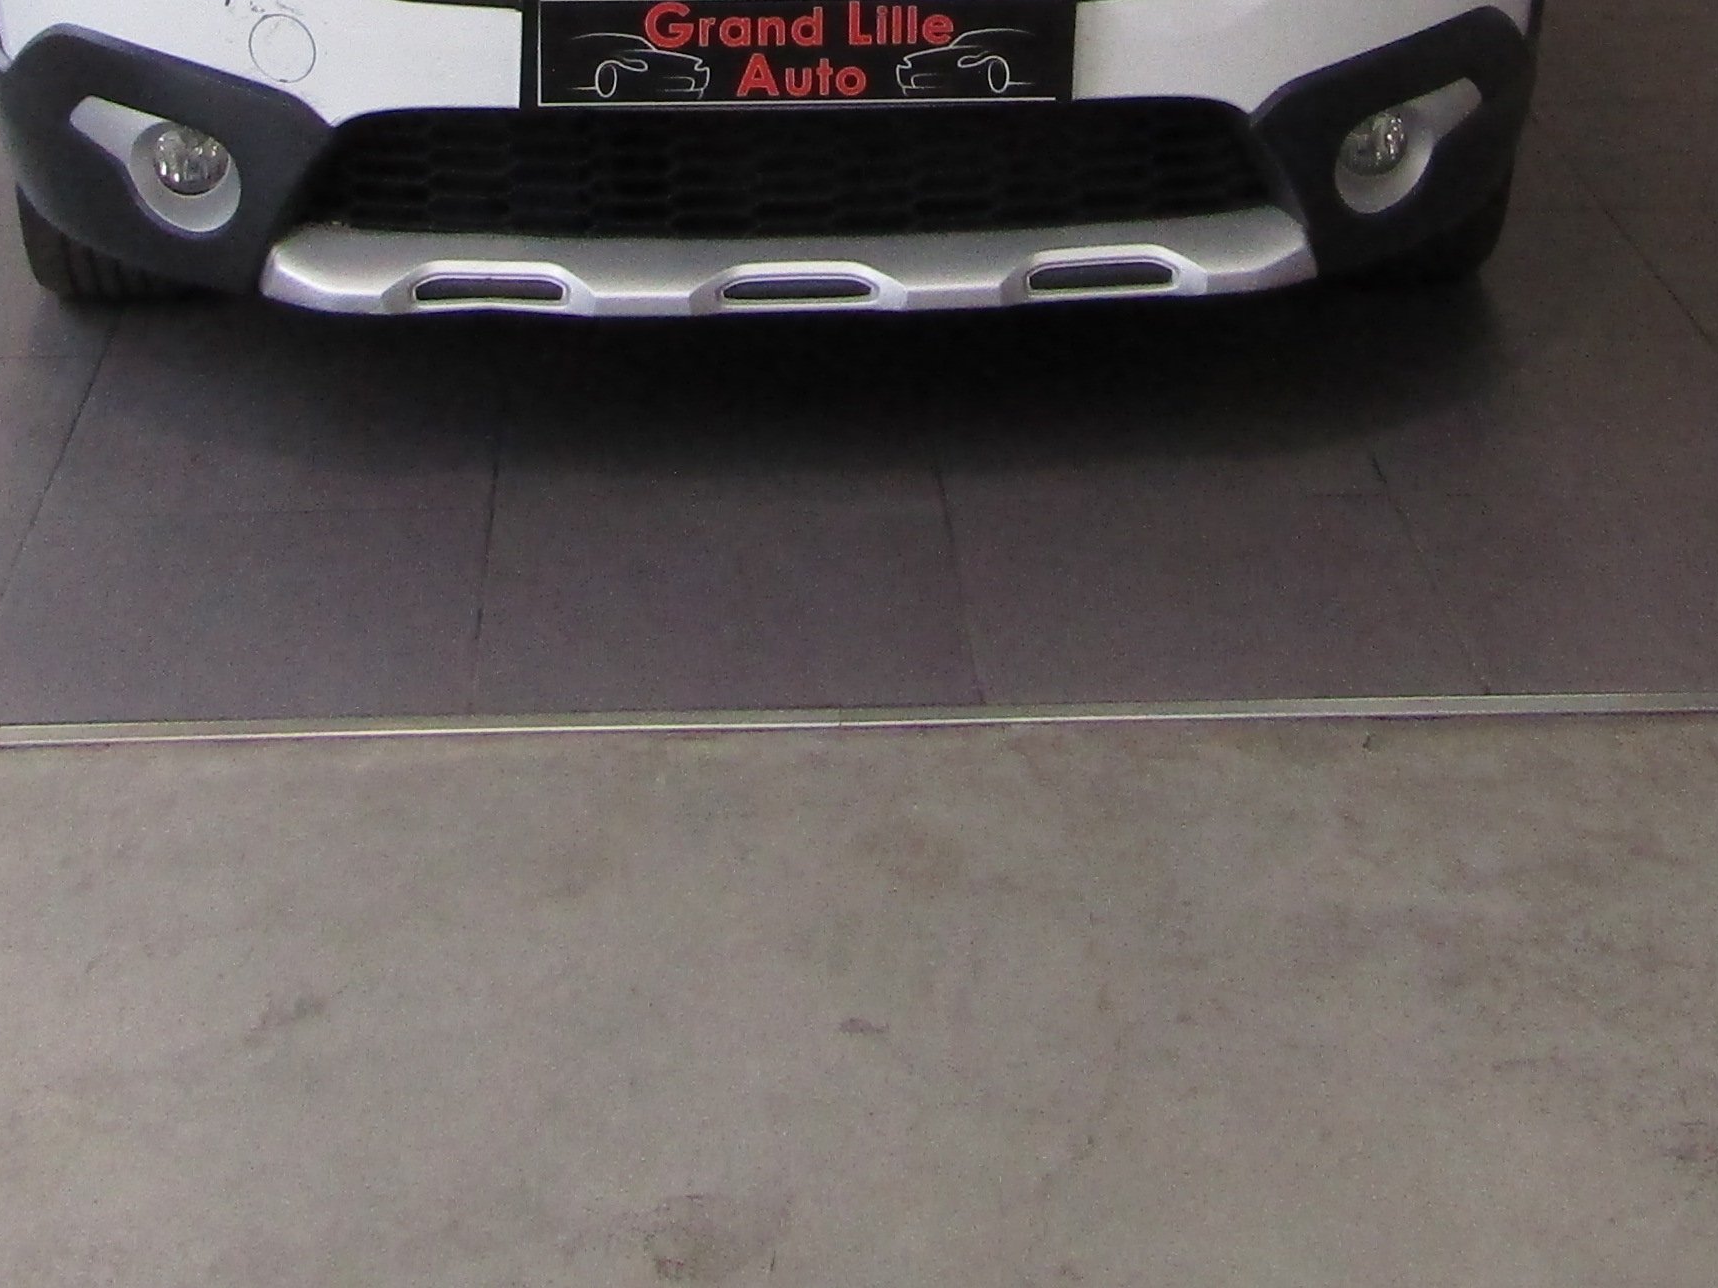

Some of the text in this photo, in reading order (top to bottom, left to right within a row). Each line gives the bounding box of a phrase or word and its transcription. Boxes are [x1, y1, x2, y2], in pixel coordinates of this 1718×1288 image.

[644, 0, 955, 49] Grand Lille
[736, 52, 867, 98] Auto
